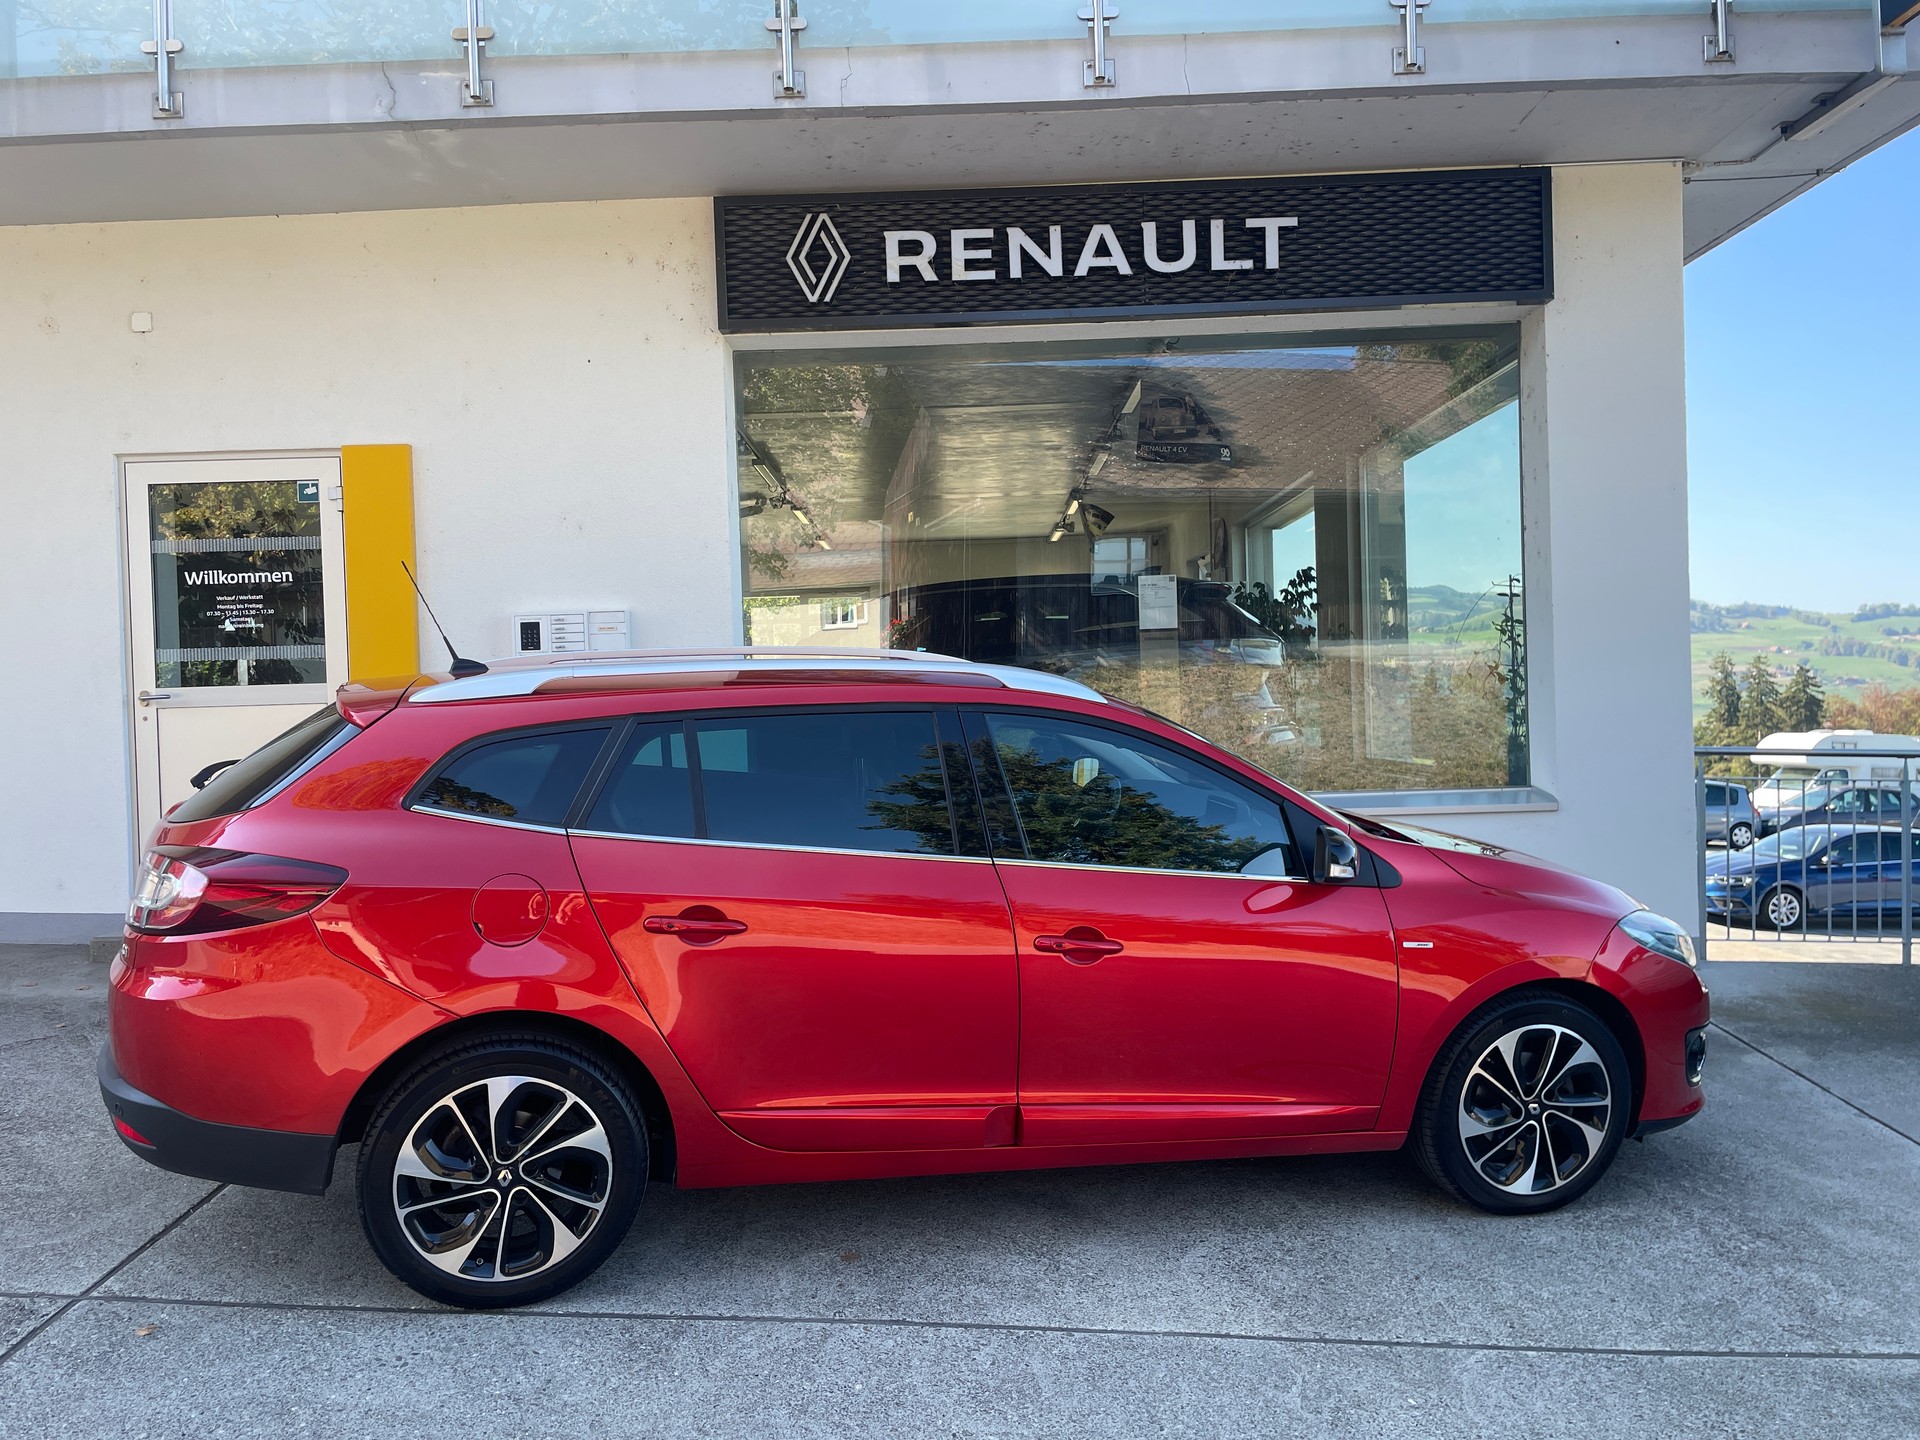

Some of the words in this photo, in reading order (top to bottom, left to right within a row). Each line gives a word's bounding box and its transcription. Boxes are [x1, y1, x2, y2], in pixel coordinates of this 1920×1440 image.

[883, 216, 1299, 283] RENAULT
[1140, 444, 1171, 453] RENAULT
[184, 570, 293, 585] Willkommen
